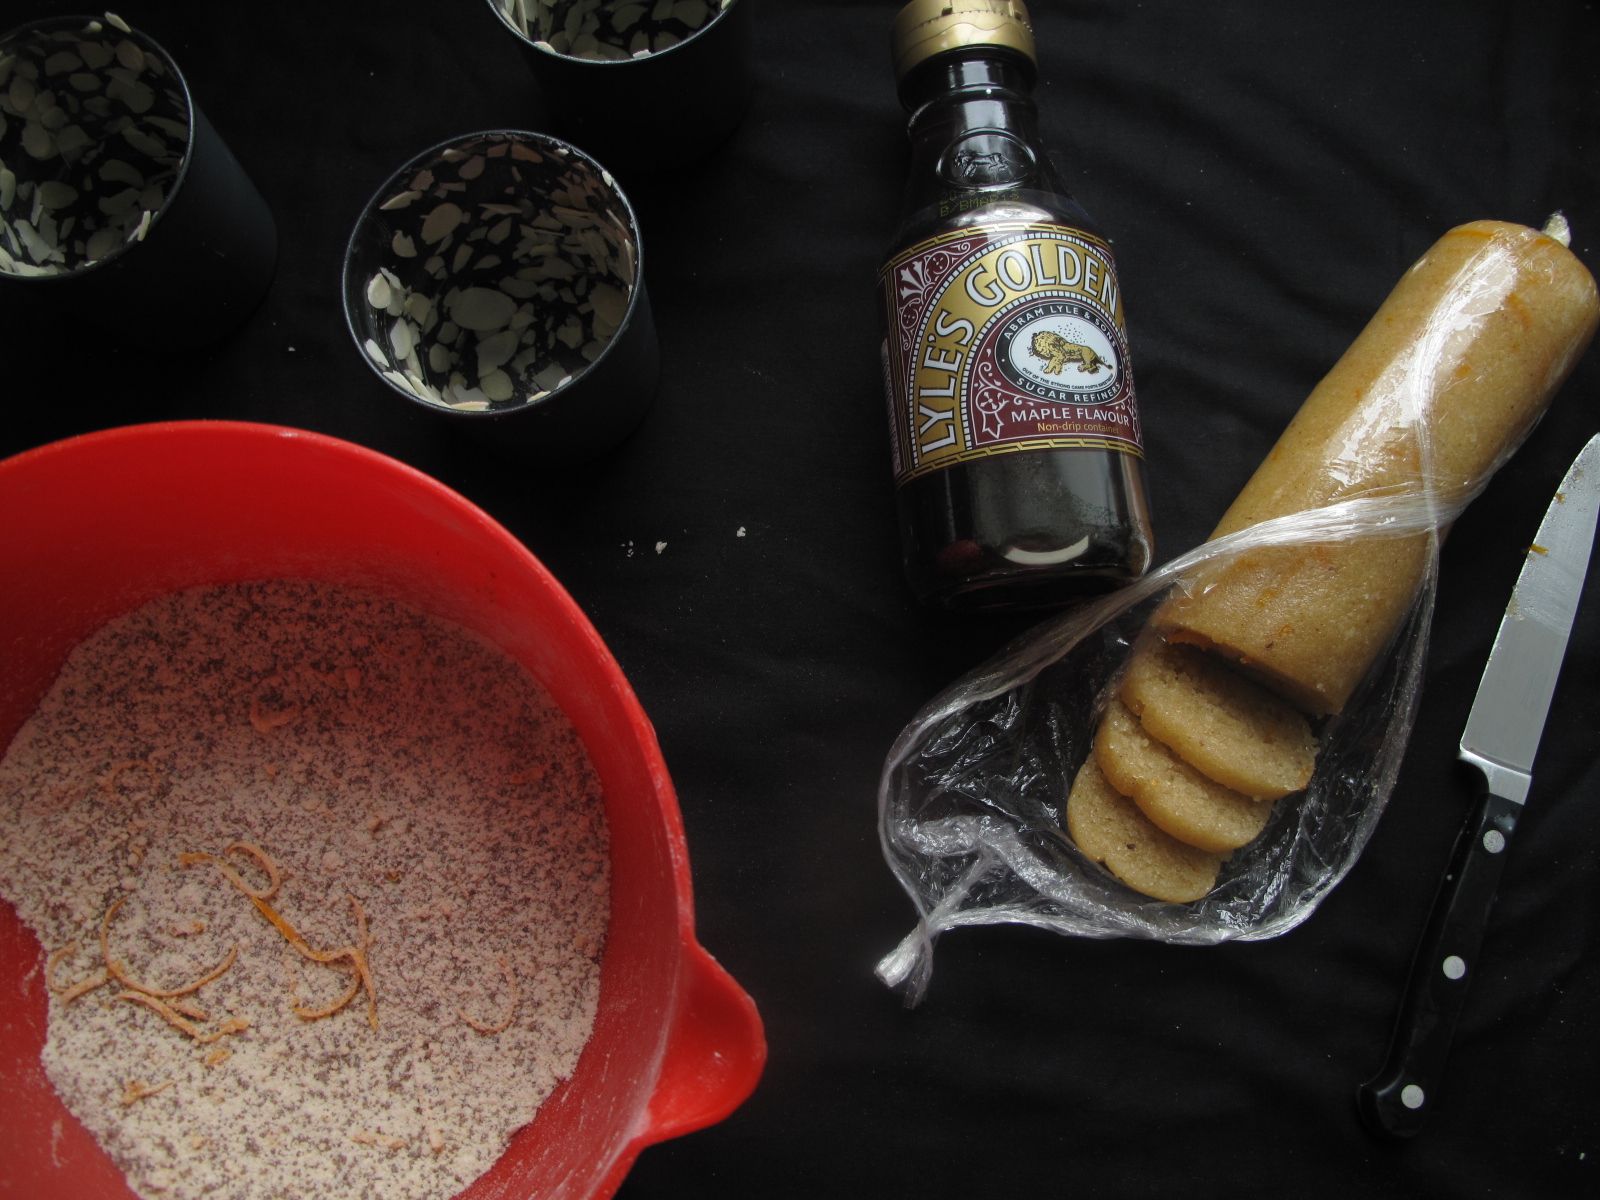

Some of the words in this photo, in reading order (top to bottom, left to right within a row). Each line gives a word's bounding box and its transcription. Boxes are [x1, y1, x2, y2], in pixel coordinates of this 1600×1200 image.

[1003, 307, 1045, 340] ABRAM
[1050, 305, 1079, 314] LYLE
[1094, 319, 1117, 347] SONS
[919, 308, 975, 458] LYLE'S
[965, 243, 1118, 317] GOLDEN
[1022, 367, 1032, 376] OUT
[1016, 377, 1067, 401] SUGAR
[1074, 382, 1121, 402] REFINERS
[1011, 407, 1072, 423] MAPLE
[1076, 408, 1130, 427] FLAVOUR
[1037, 421, 1081, 433] Non-drip
[1083, 422, 1119, 434] container
